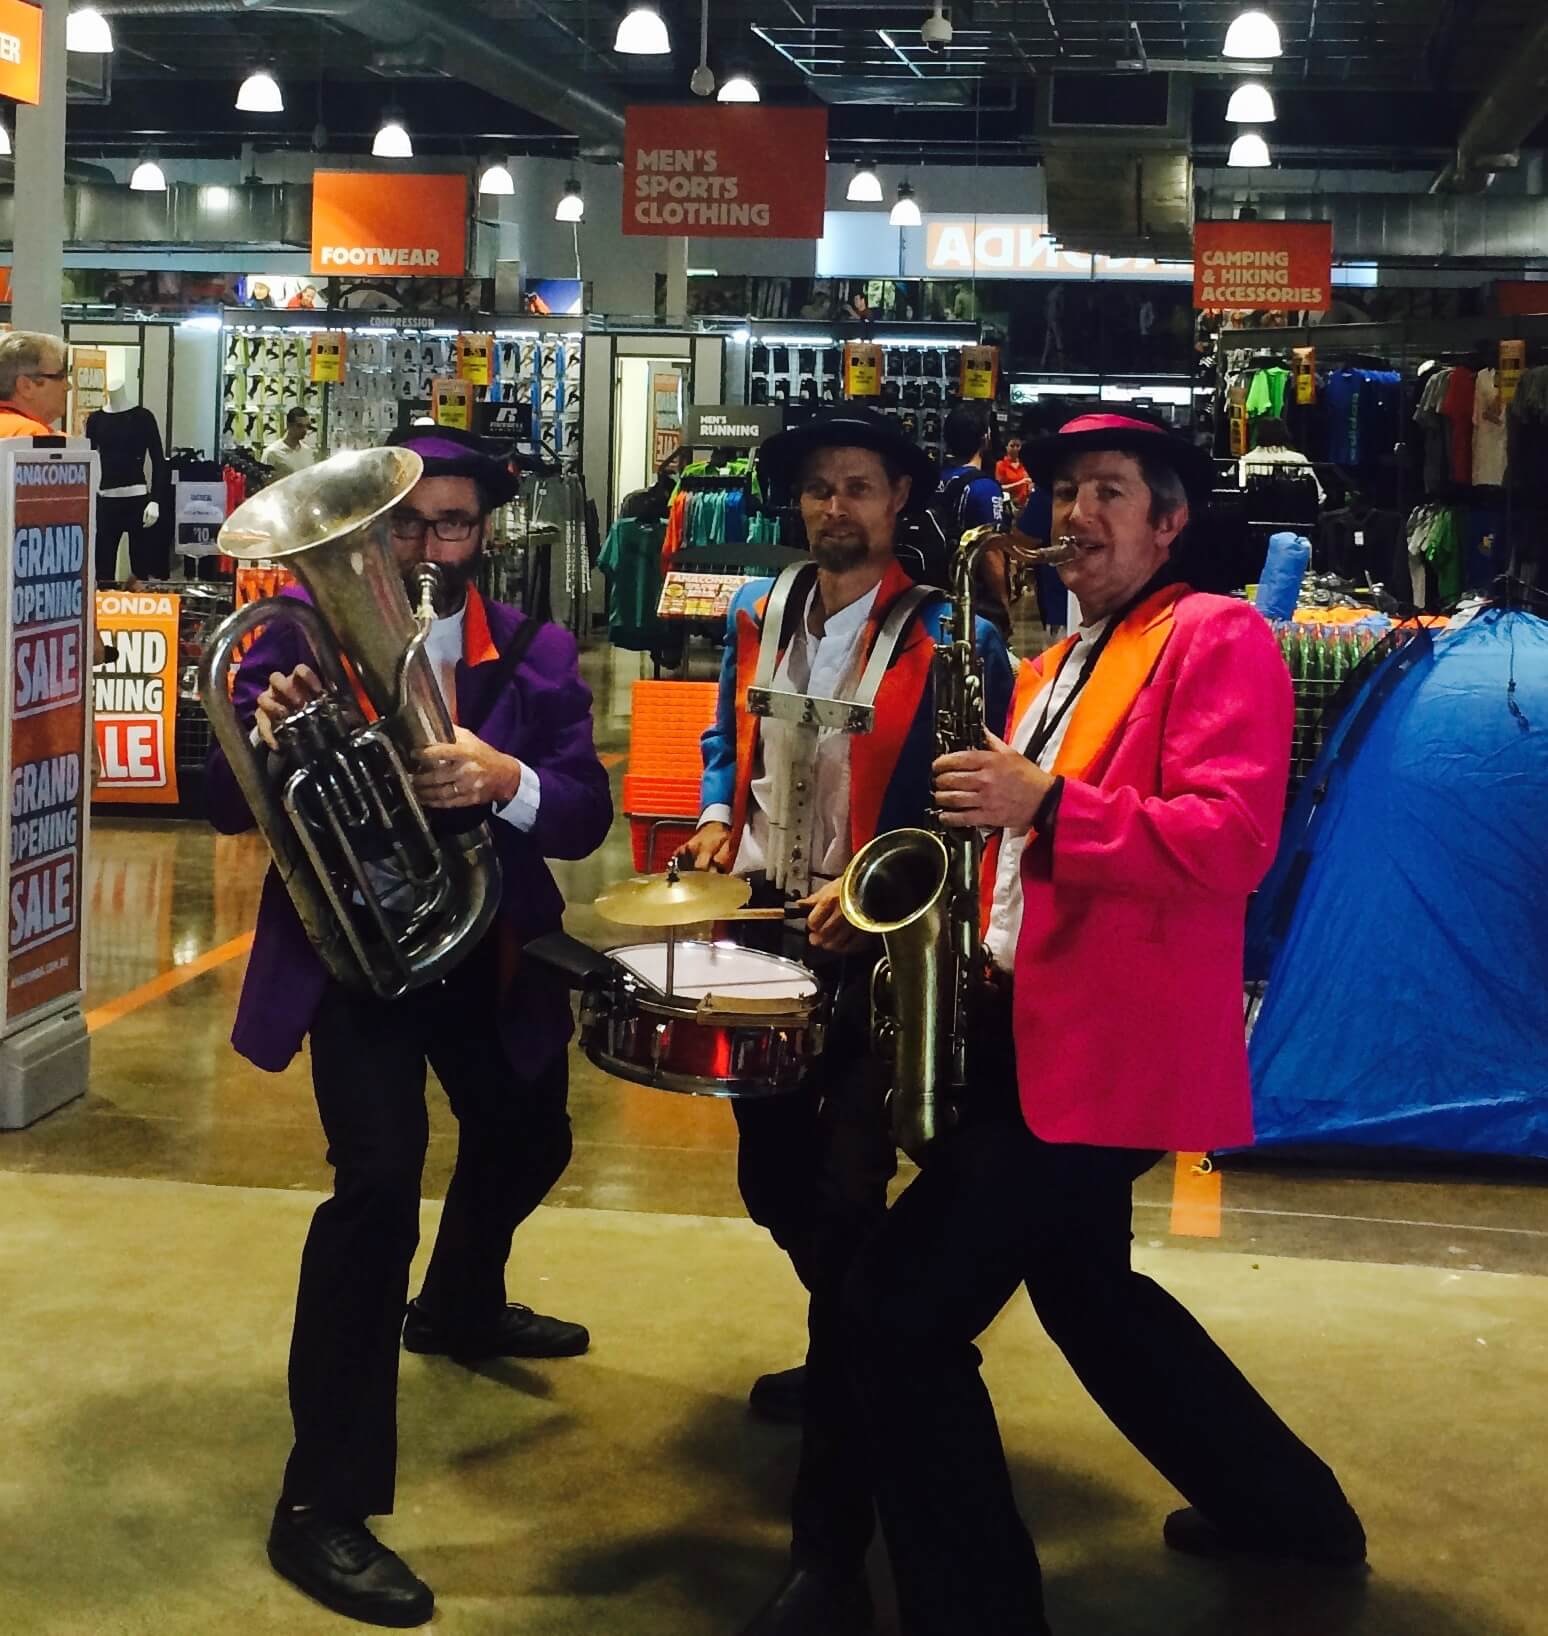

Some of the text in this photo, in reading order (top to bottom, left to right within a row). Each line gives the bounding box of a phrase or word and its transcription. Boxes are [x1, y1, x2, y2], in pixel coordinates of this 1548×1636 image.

[636, 149, 717, 172] MEN'S
[635, 176, 738, 199] SPORTS
[635, 202, 770, 226] CLOTHING
[321, 246, 439, 266] FOOTWEAR
[1203, 251, 1288, 267] CAMPING
[1202, 269, 1289, 285] & HIKING
[1202, 287, 1321, 303] ACCESSORIES
[369, 316, 435, 328] COMPRESSION
[700, 415, 727, 425] MEN'S
[700, 425, 760, 437] RUNNING
[16, 464, 86, 486] ANACONDA
[15, 525, 84, 578] GRAND
[13, 579, 82, 624] OPENING
[17, 635, 76, 706] SALE
[92, 679, 163, 712] NING
[11, 753, 79, 817] GRAND
[10, 807, 77, 865] OPENING
[11, 862, 71, 946] SALE
